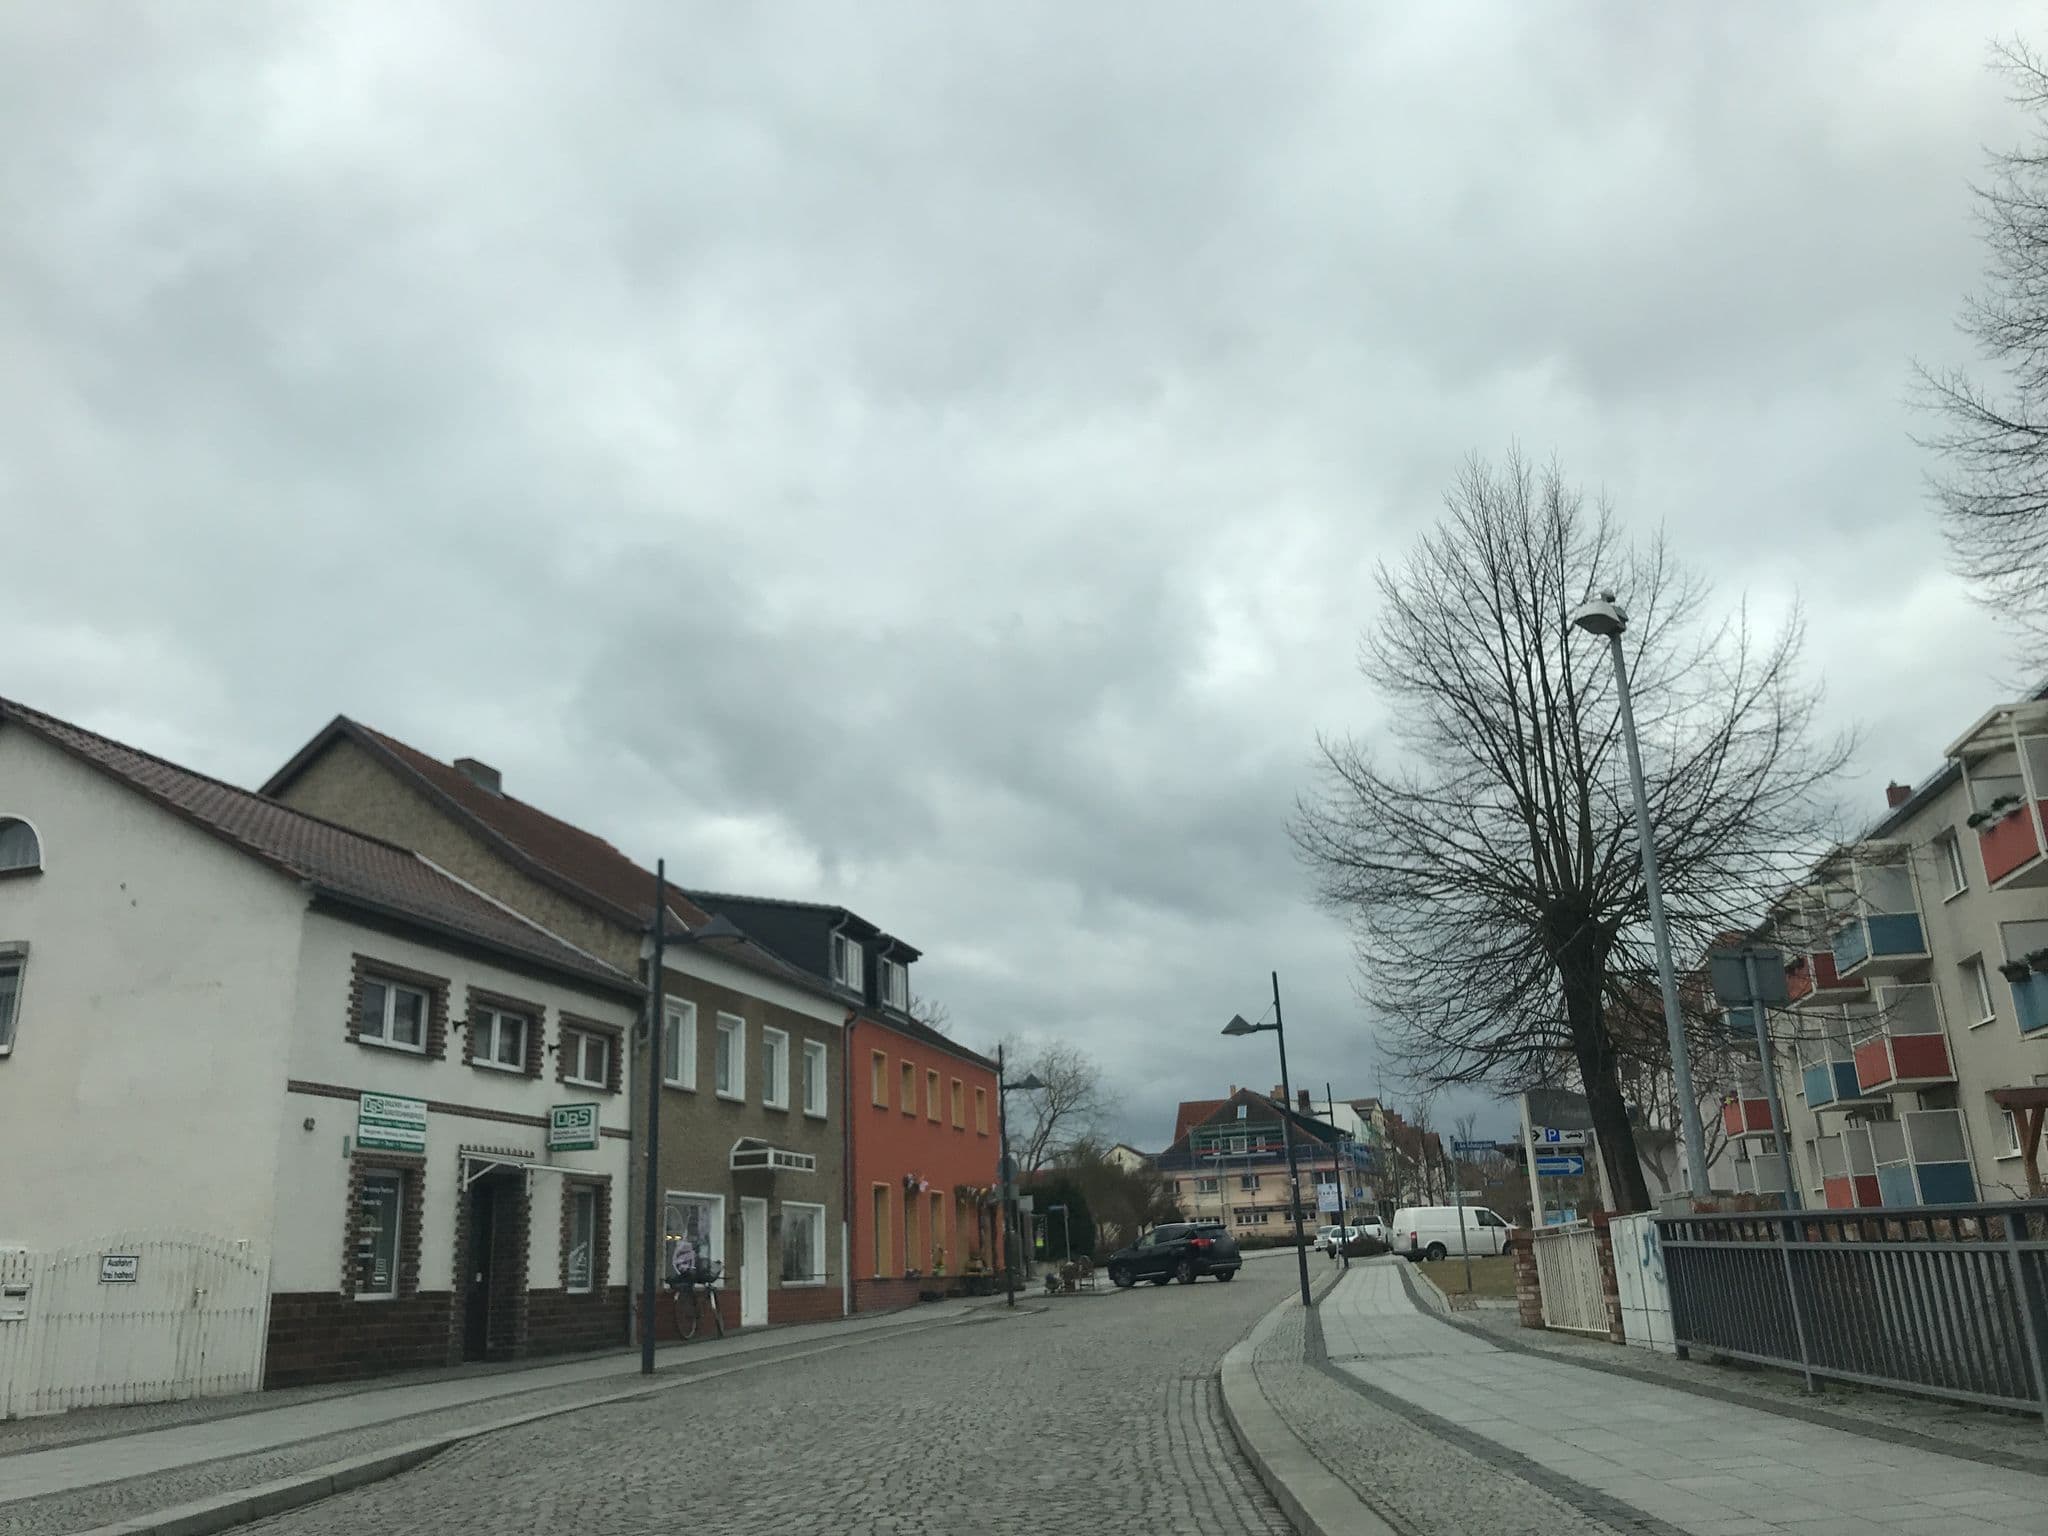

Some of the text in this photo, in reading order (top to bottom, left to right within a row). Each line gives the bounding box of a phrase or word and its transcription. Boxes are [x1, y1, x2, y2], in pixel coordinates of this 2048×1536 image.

[557, 1109, 590, 1128] DBS
[1548, 1128, 1557, 1140] P
[107, 1259, 133, 1267] Ausfahrt
